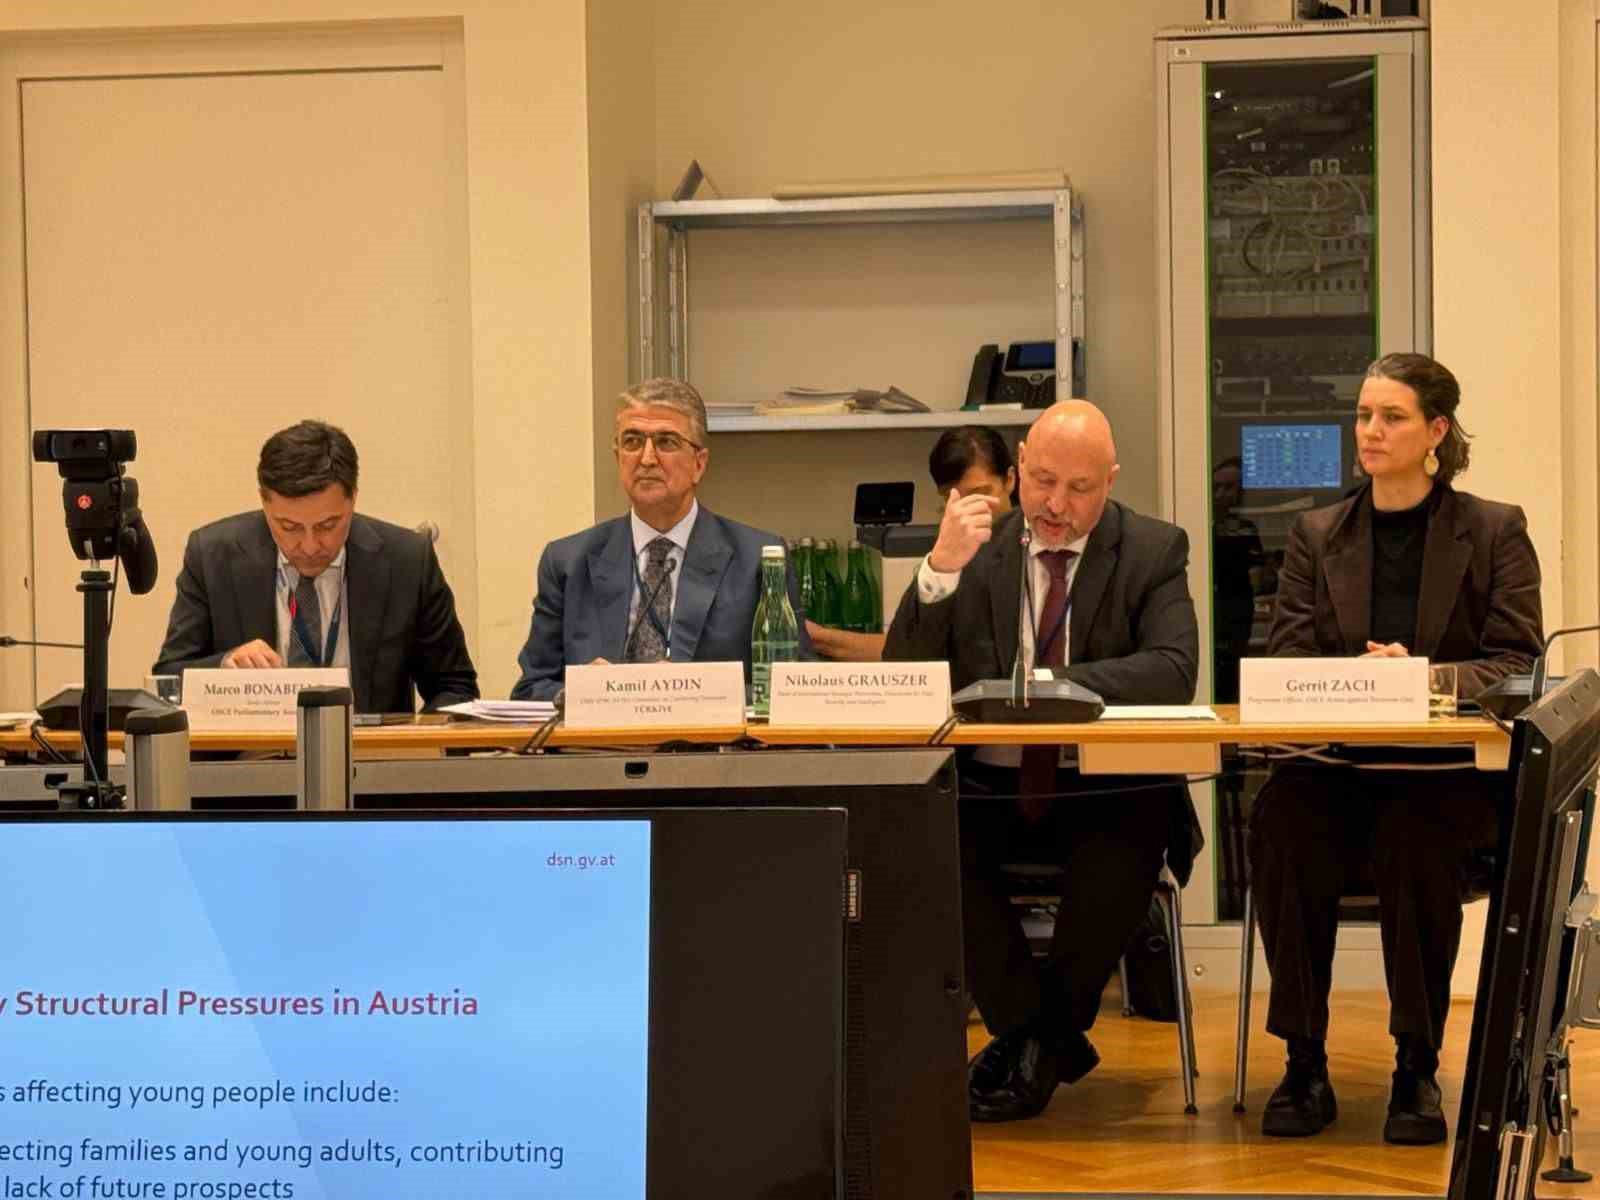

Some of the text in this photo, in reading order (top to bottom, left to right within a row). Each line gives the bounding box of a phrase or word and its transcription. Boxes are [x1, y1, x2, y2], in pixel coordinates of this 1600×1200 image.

[605, 678, 702, 692] Kamil AYDIN
[785, 673, 928, 687] Nikolaus GRAUSZER
[1285, 679, 1376, 692] Gerrit ZACH
[203, 683, 312, 696] Marco BONABE
[547, 852, 615, 870] dsn.gv.at
[16, 989, 168, 1015] Structural
[179, 991, 324, 1015] Pressures
[334, 989, 359, 1015] in
[368, 989, 477, 1015] Austria
[13, 1080, 120, 1109] affecting
[129, 1086, 204, 1109] young
[213, 1080, 295, 1109] people
[304, 1080, 398, 1102] include:
[0, 1138, 563, 1169] ecting families and young adults, contributing
[5, 1176, 293, 1200] lack of future prospects
